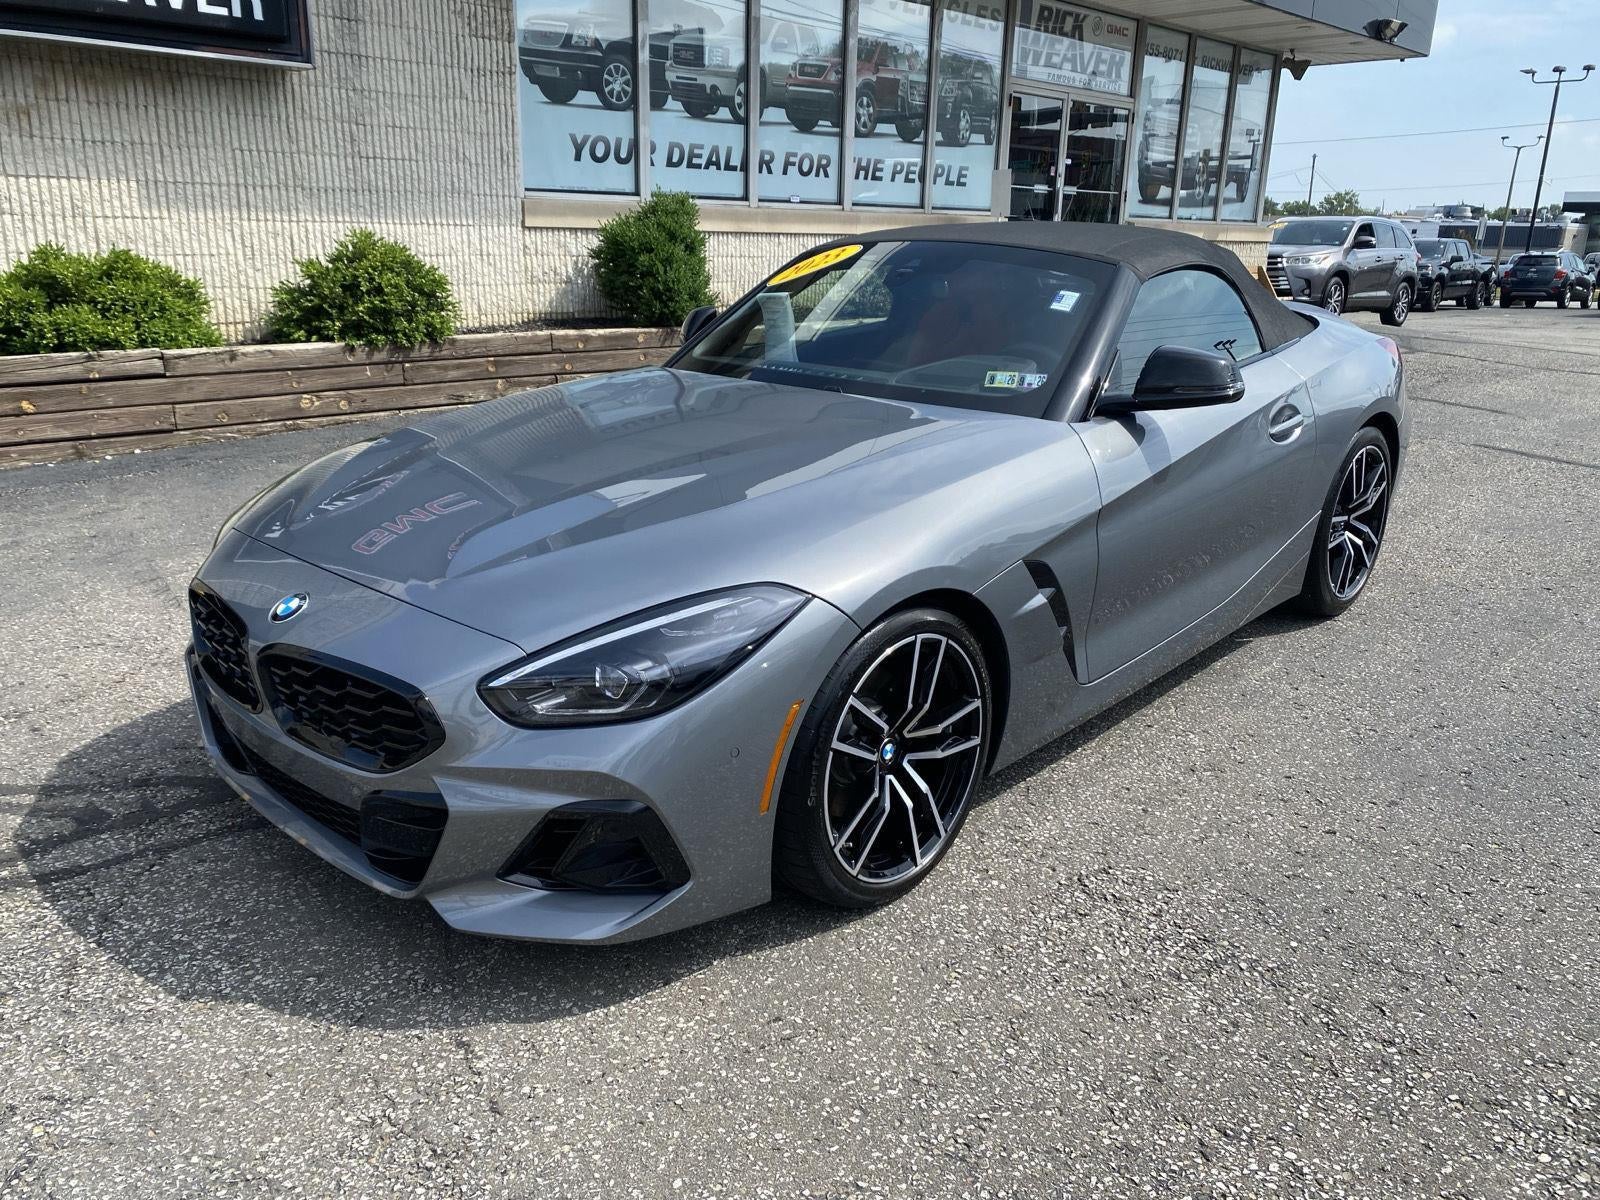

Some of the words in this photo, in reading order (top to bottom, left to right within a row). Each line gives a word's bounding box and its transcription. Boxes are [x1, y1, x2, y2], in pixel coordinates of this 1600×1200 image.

[1034, 4, 1090, 42] RICK
[1107, 23, 1129, 37] GMC
[1018, 31, 1126, 79] WEAVER
[782, 151, 832, 179] FOR
[853, 156, 885, 182] HE
